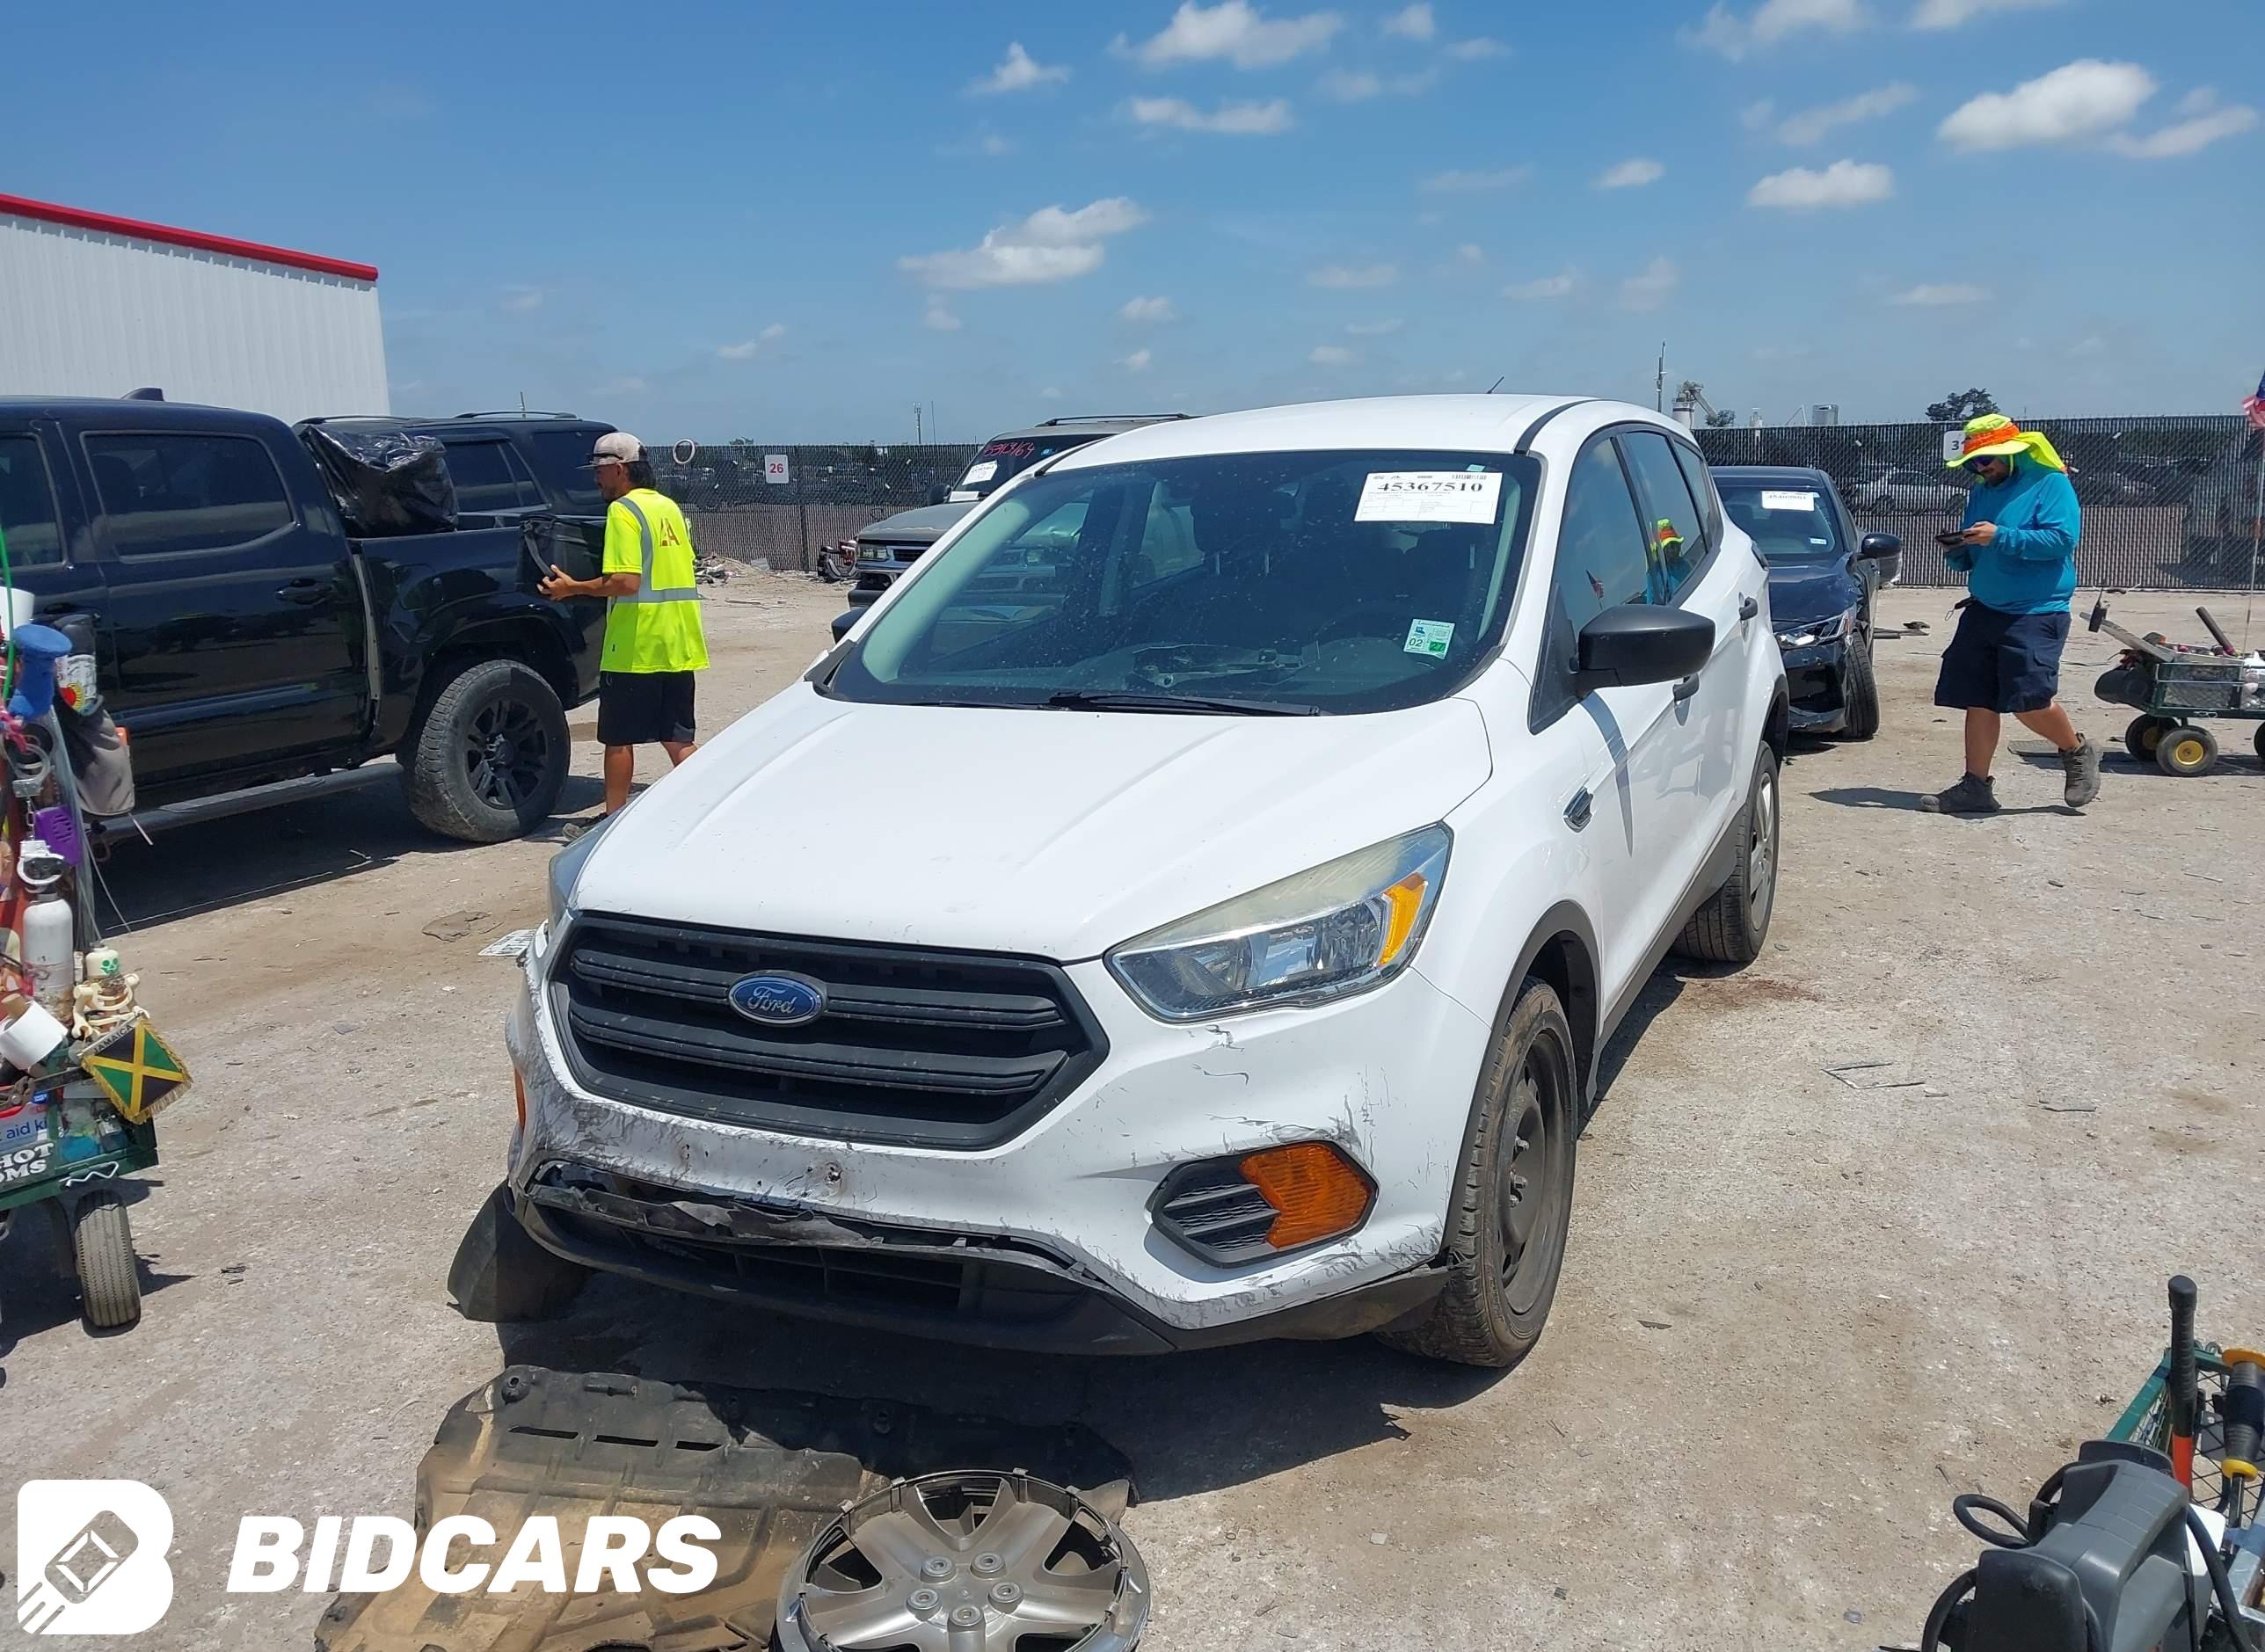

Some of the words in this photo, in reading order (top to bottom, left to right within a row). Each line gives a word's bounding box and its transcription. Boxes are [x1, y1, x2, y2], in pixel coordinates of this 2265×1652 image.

[769, 462, 784, 474] 26
[1378, 482, 1483, 492] 45367510
[1409, 637, 1424, 647] 02
[747, 986, 797, 1014] Ford
[93, 1024, 134, 1053] JAMAICA
[6, 1121, 31, 1139] aid
[34, 1117, 47, 1132] ki
